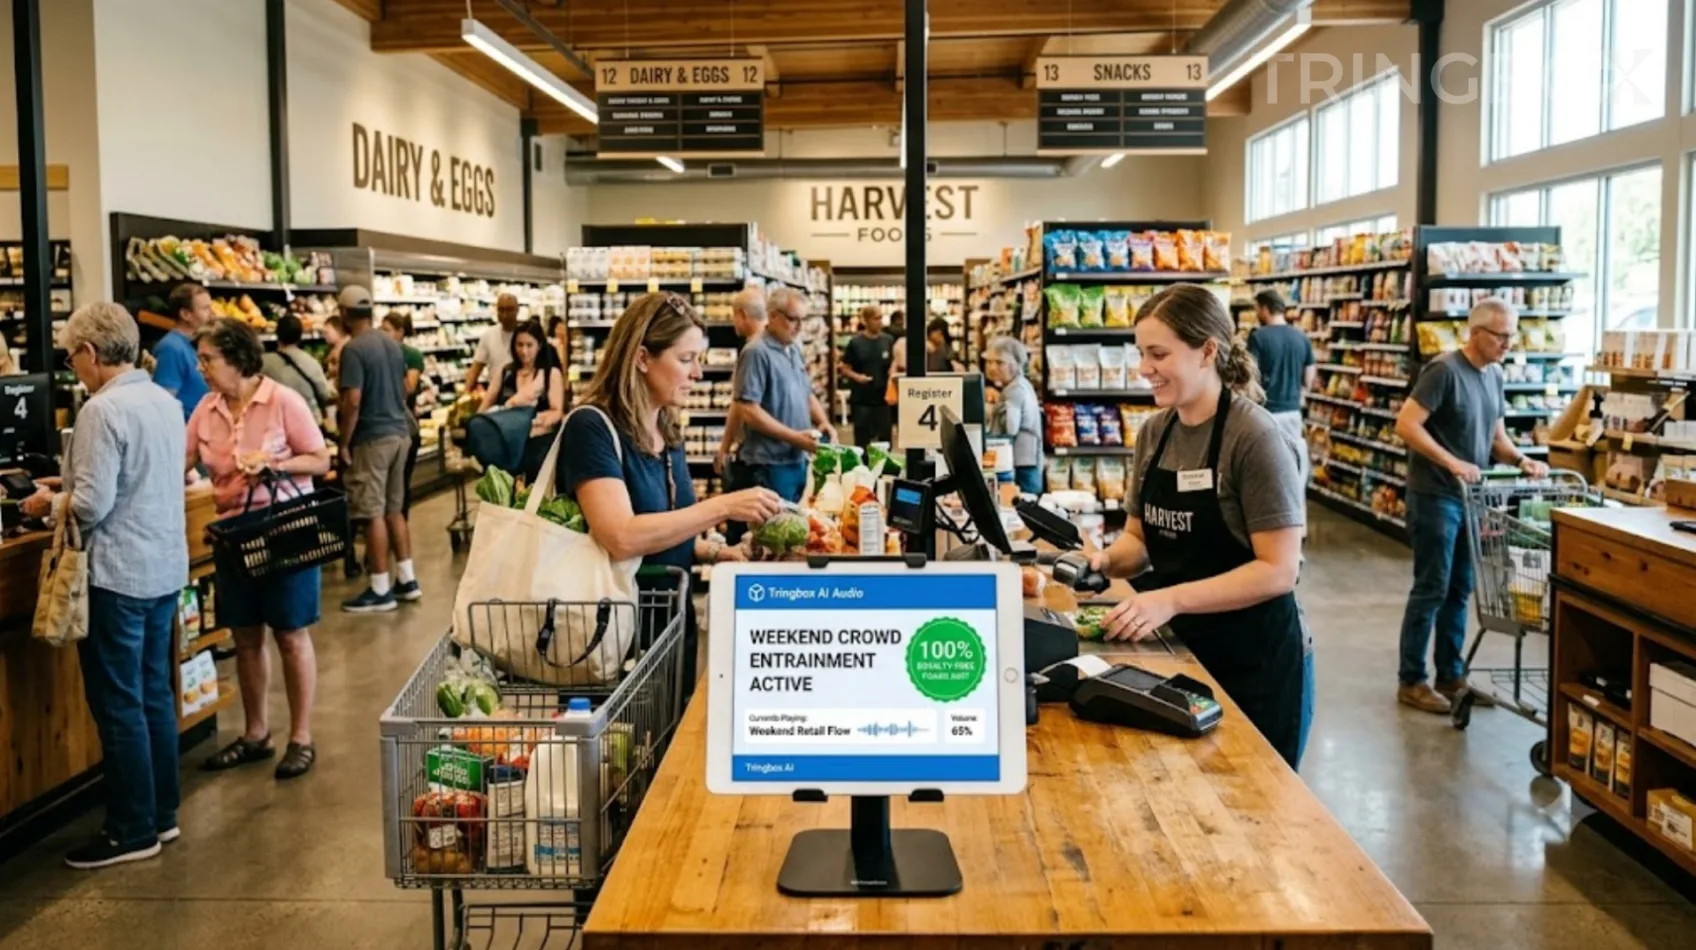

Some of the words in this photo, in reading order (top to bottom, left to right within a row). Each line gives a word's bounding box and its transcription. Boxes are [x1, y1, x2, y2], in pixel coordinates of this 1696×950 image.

[602, 67, 617, 85] 12
[630, 66, 672, 85] DAIRY
[677, 66, 688, 84] &
[692, 65, 730, 84] EGGS
[743, 65, 757, 83] 12
[1043, 64, 1059, 81] 13
[1093, 63, 1152, 81] SNACKS
[1187, 64, 1201, 81] 13
[352, 121, 424, 202] DAIRY
[430, 149, 446, 208] &
[450, 155, 495, 219] EGGS
[907, 387, 953, 400] Register
[14, 396, 28, 420] 4
[918, 404, 938, 432] 4
[768, 586, 816, 601] Tringbox
[818, 586, 829, 599] AI
[832, 586, 864, 599] Audio
[750, 629, 833, 645] WEEKEND
[838, 629, 902, 645] CROWD
[920, 640, 974, 660] 100%
[750, 652, 877, 669] ENTRAINMENT
[749, 676, 813, 692] ACTIVE
[749, 725, 795, 736] Weekend
[797, 725, 826, 736] Retail
[827, 725, 851, 736] Flow
[951, 725, 973, 736] 65%
[745, 763, 783, 775] Tringbox
